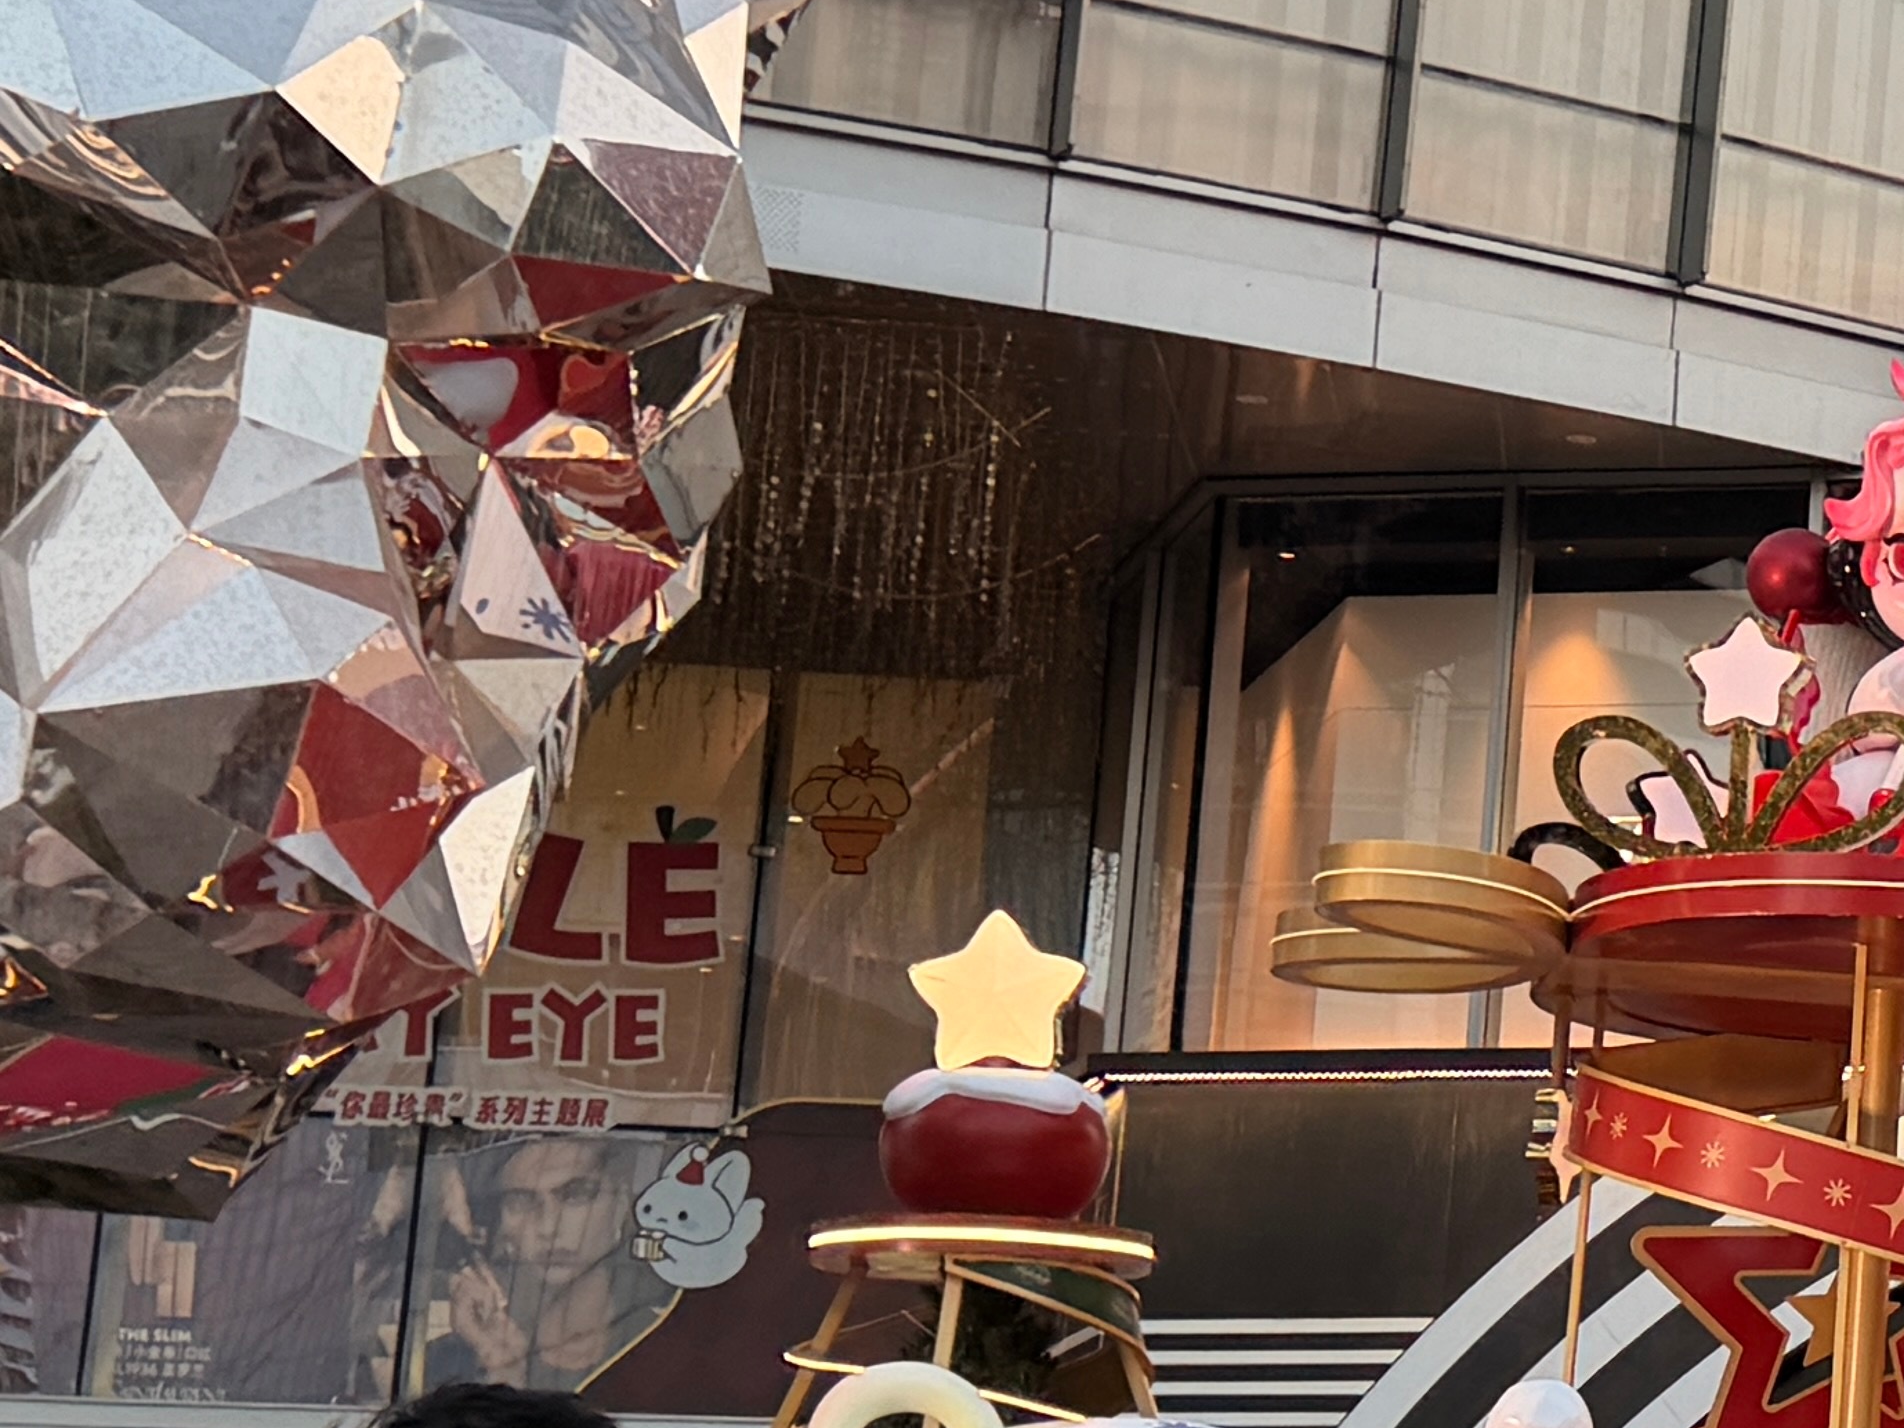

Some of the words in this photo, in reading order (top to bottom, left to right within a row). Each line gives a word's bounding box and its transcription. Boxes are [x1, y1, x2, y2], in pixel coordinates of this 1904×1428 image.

[487, 986, 664, 1063] EYE
[474, 1094, 611, 1129] 系列主题展
